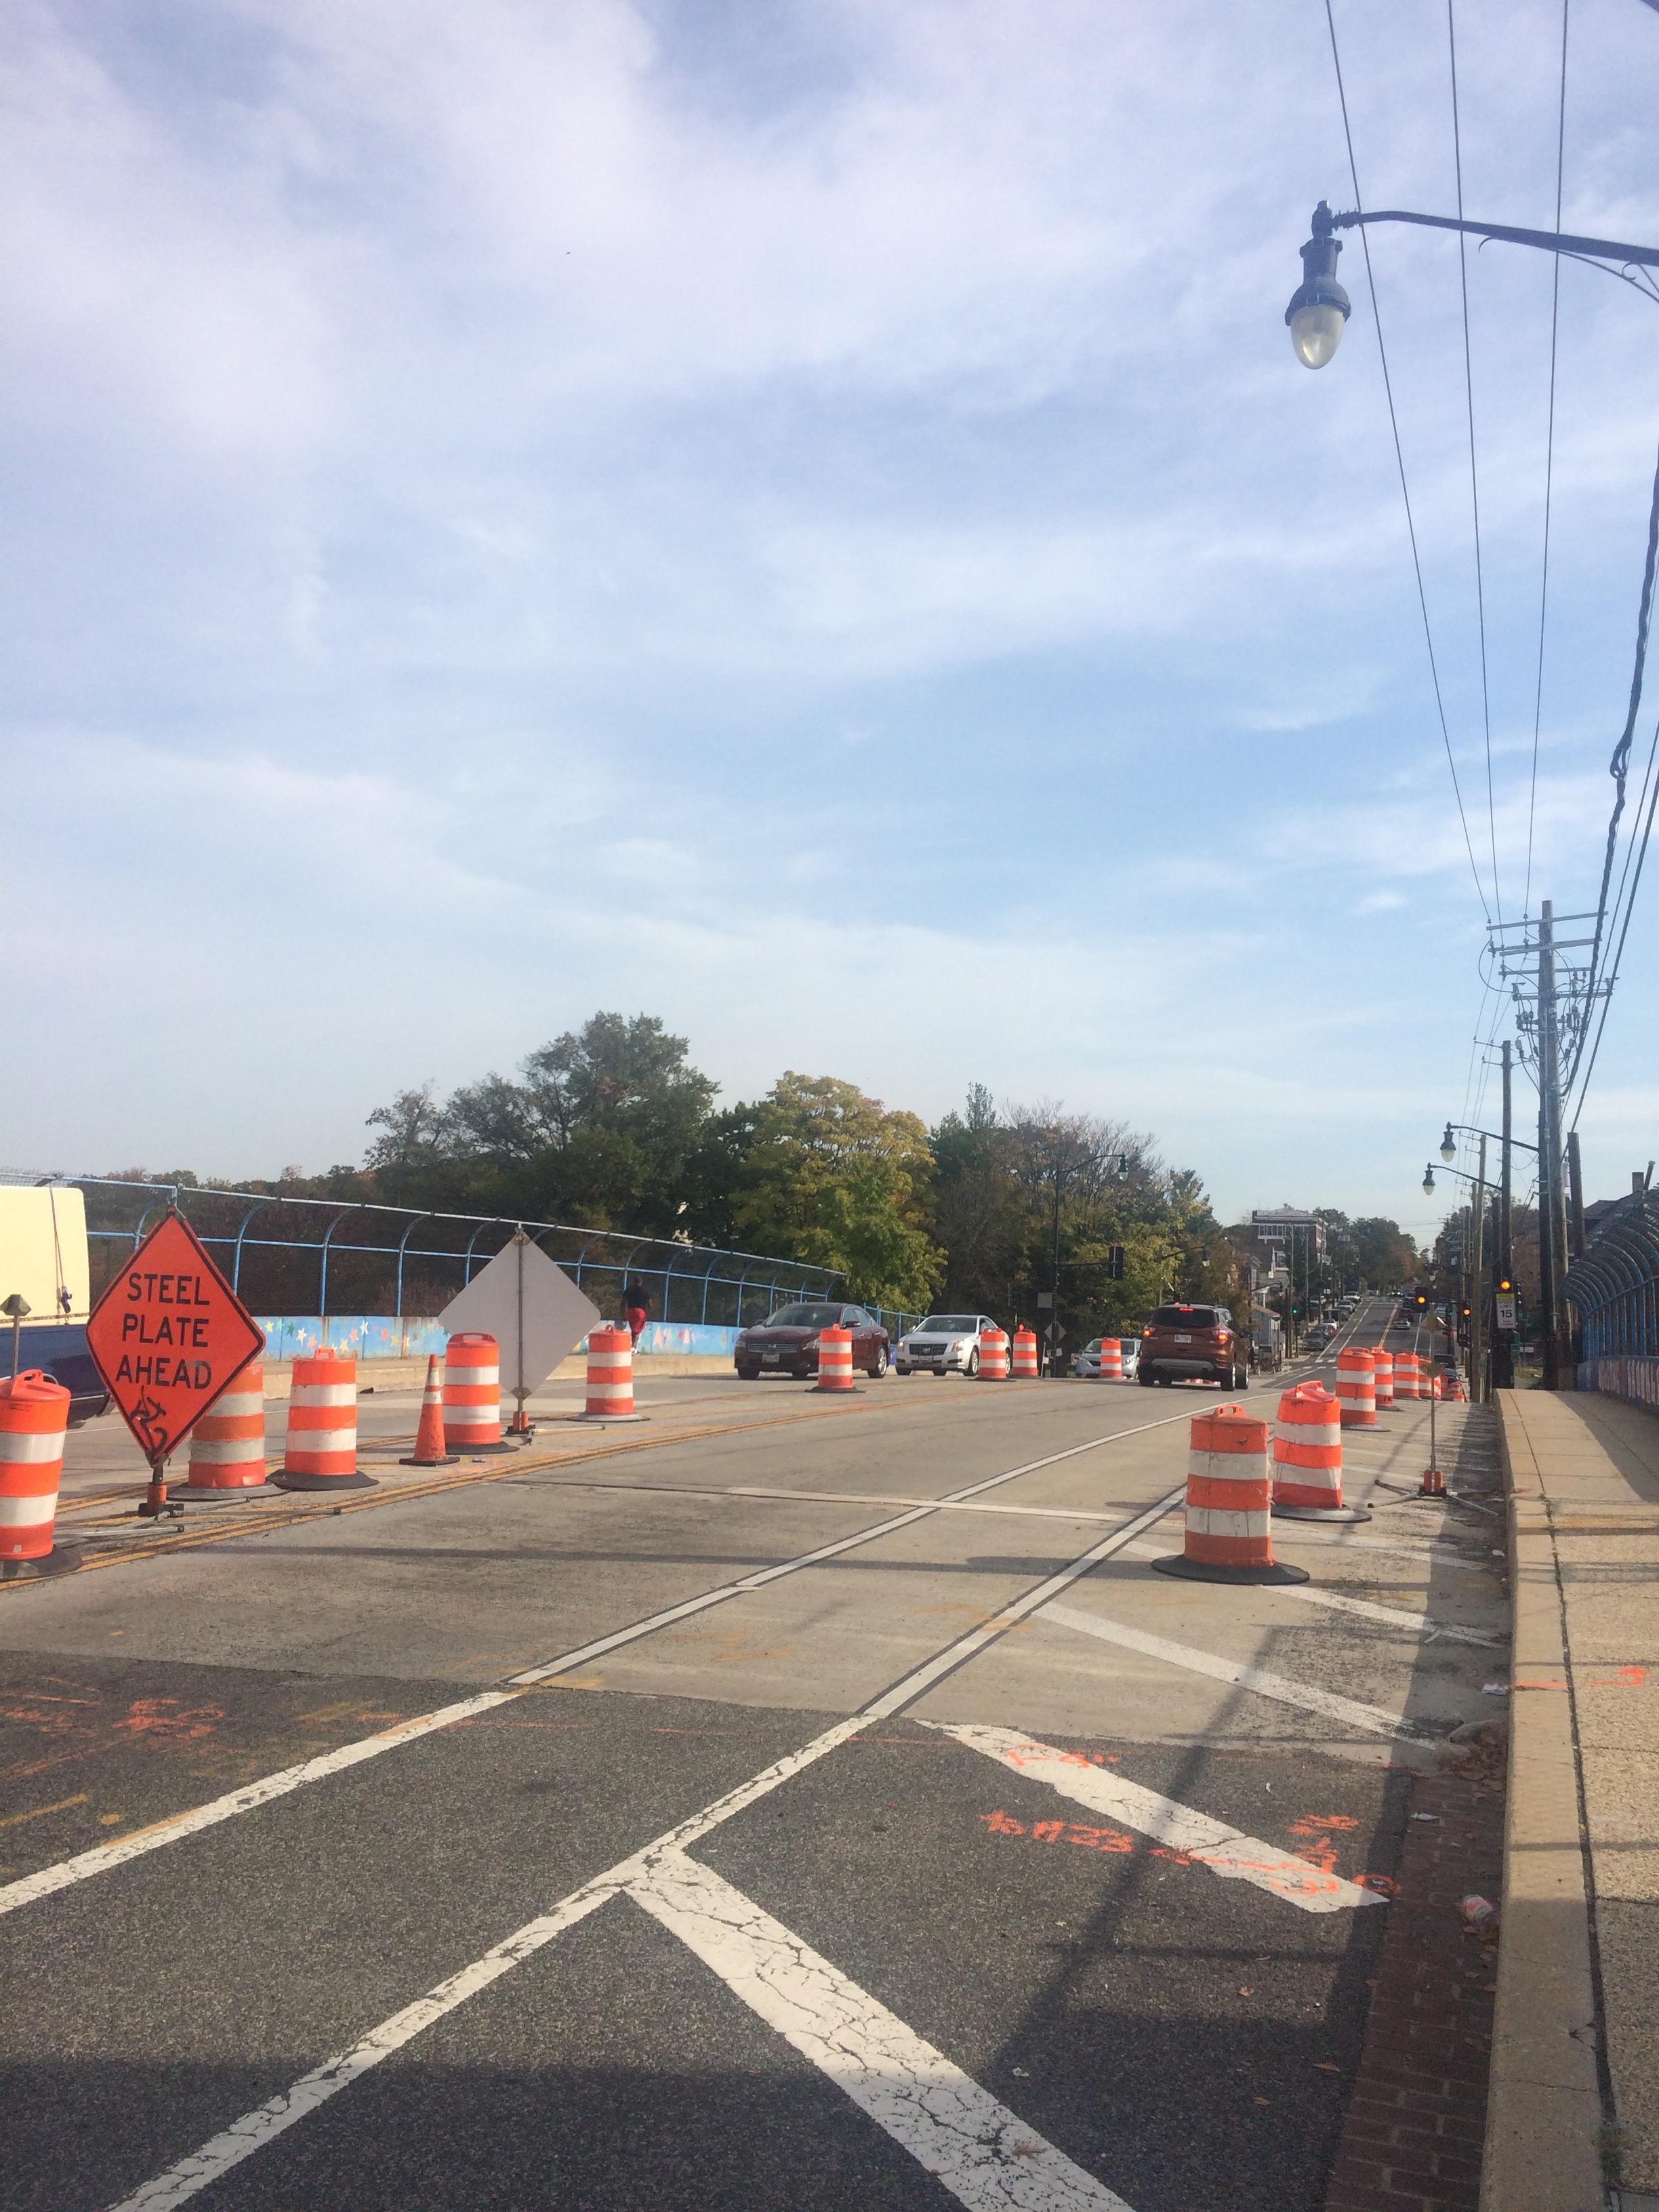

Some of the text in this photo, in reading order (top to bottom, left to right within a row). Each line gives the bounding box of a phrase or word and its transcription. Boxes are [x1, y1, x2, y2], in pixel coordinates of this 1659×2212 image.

[127, 1273, 209, 1305] STEEL
[123, 1313, 209, 1347] PLATE
[1500, 1309, 1513, 1318] 15
[115, 1355, 212, 1389] AHEAD
